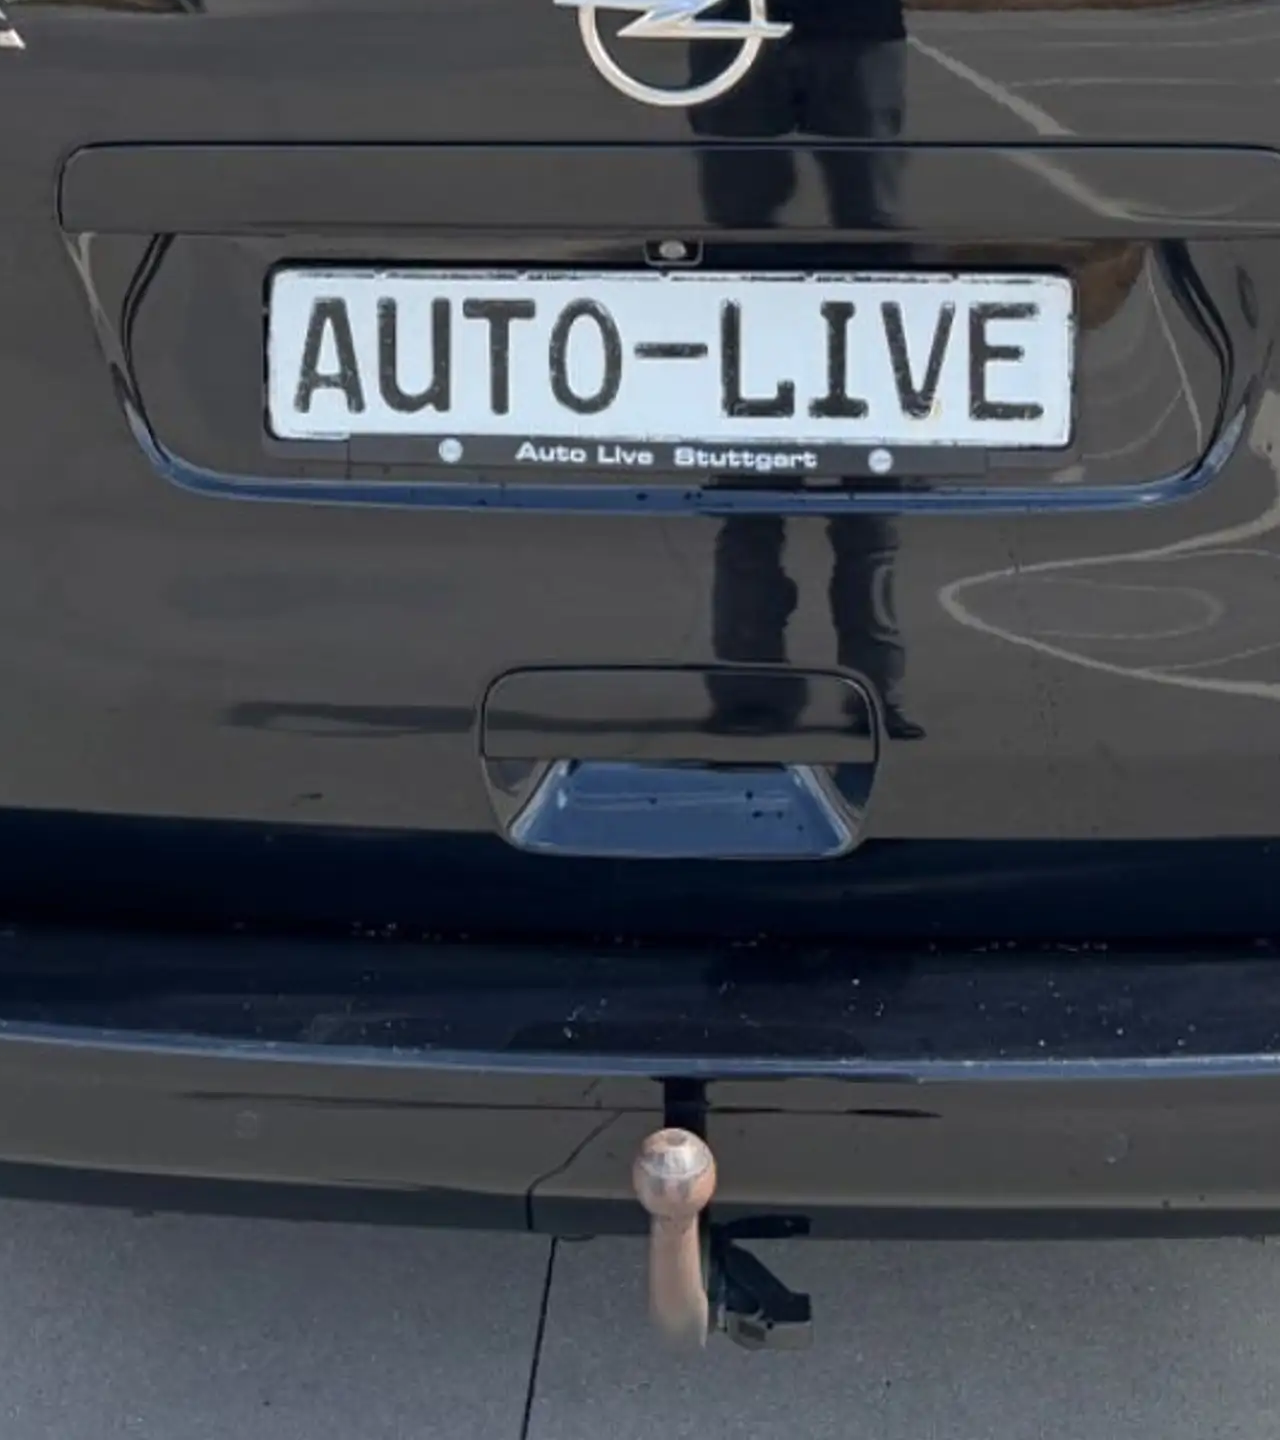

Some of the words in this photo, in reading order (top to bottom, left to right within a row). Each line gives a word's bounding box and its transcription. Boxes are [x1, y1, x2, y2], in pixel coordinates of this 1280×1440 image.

[293, 296, 1045, 420] AUTO-LIVE
[515, 443, 587, 466] Auto
[597, 444, 655, 468] Live
[673, 446, 818, 473] Stuttgart
